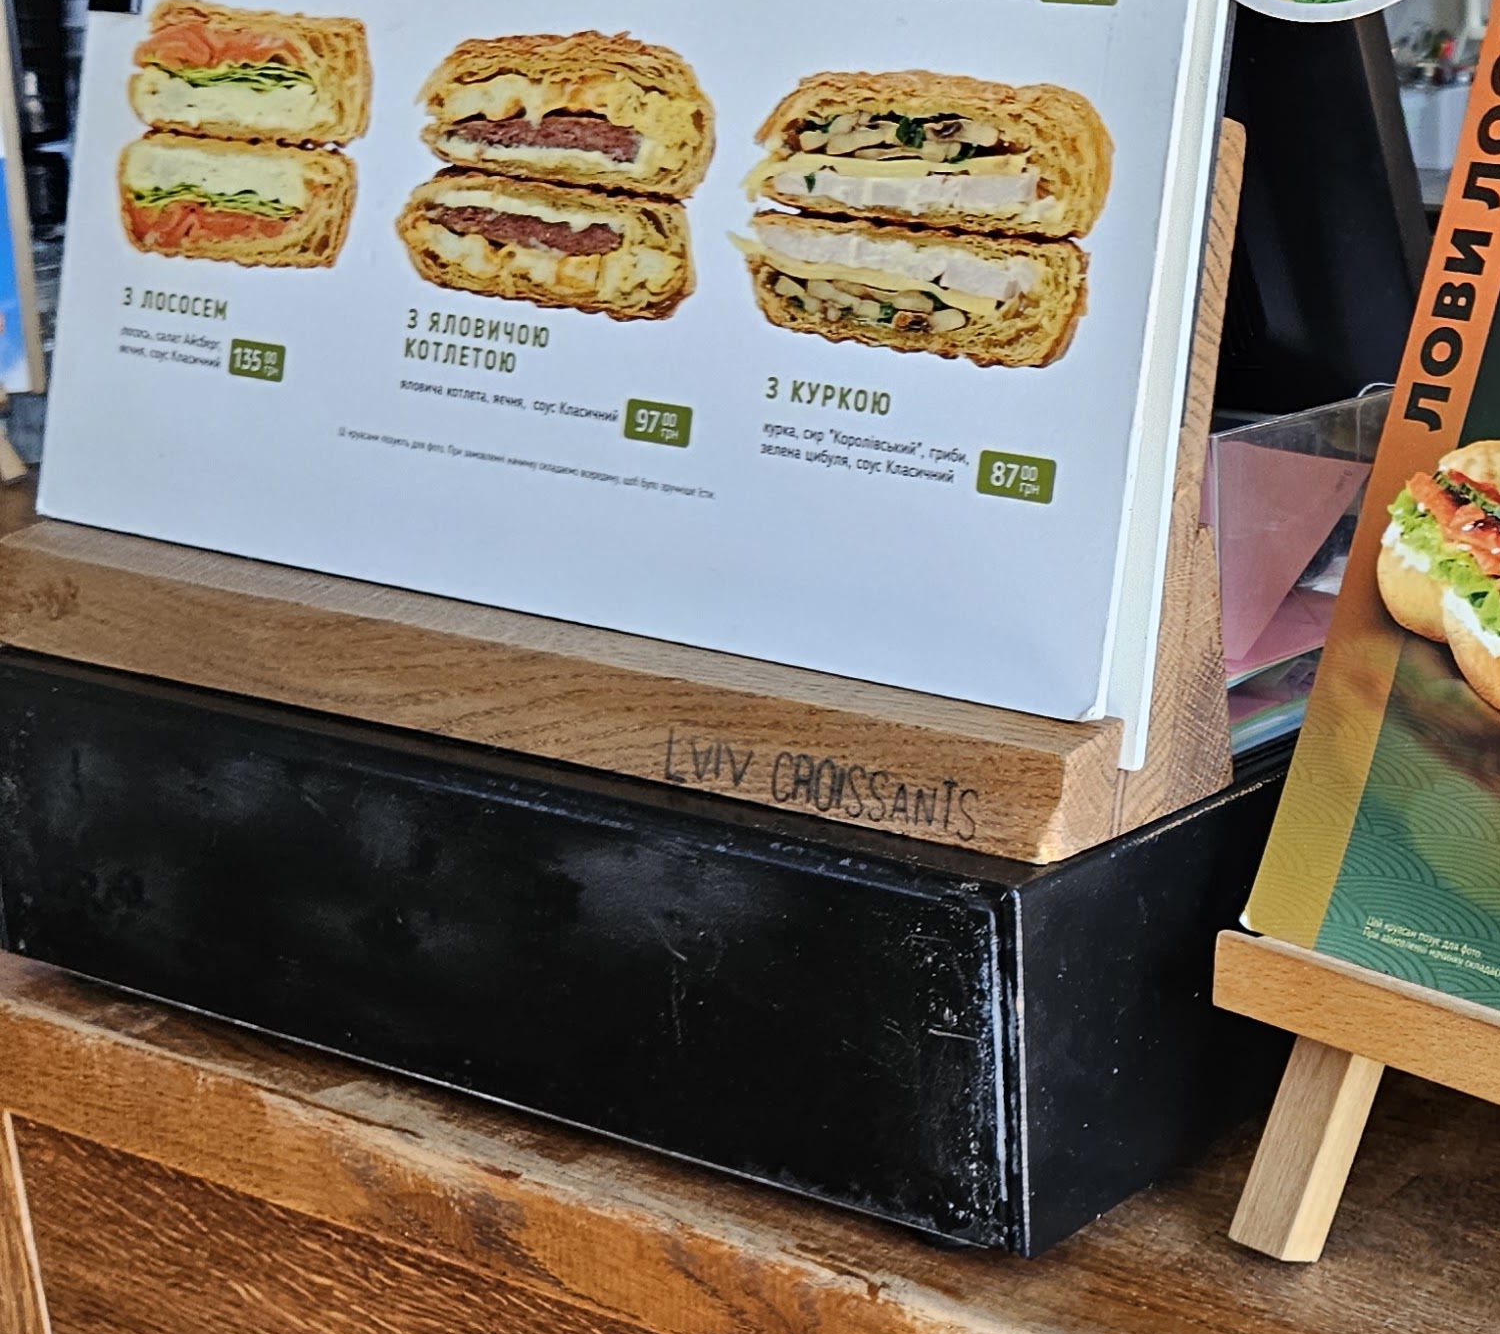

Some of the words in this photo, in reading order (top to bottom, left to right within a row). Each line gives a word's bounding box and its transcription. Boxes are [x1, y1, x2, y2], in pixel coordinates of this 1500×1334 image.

[122, 286, 133, 306] З
[140, 290, 229, 320] ЛОСОСЕМ
[407, 308, 419, 329] З
[427, 311, 550, 349] ЯЛОВИЧОЮ
[1402, 227, 1494, 434] ЛОВИ
[232, 347, 262, 372] 135
[403, 337, 517, 374] КОТЛЕТОЮ
[765, 376, 780, 400] З
[790, 379, 892, 416] КУРКОЮ
[633, 408, 661, 434] 97
[661, 411, 678, 428] 00
[759, 442, 801, 460] зелена
[855, 456, 882, 474] соус
[928, 446, 970, 466] гриби,
[989, 461, 1021, 489] 87
[1020, 465, 1039, 482] 00
[1018, 482, 1040, 497] грн
